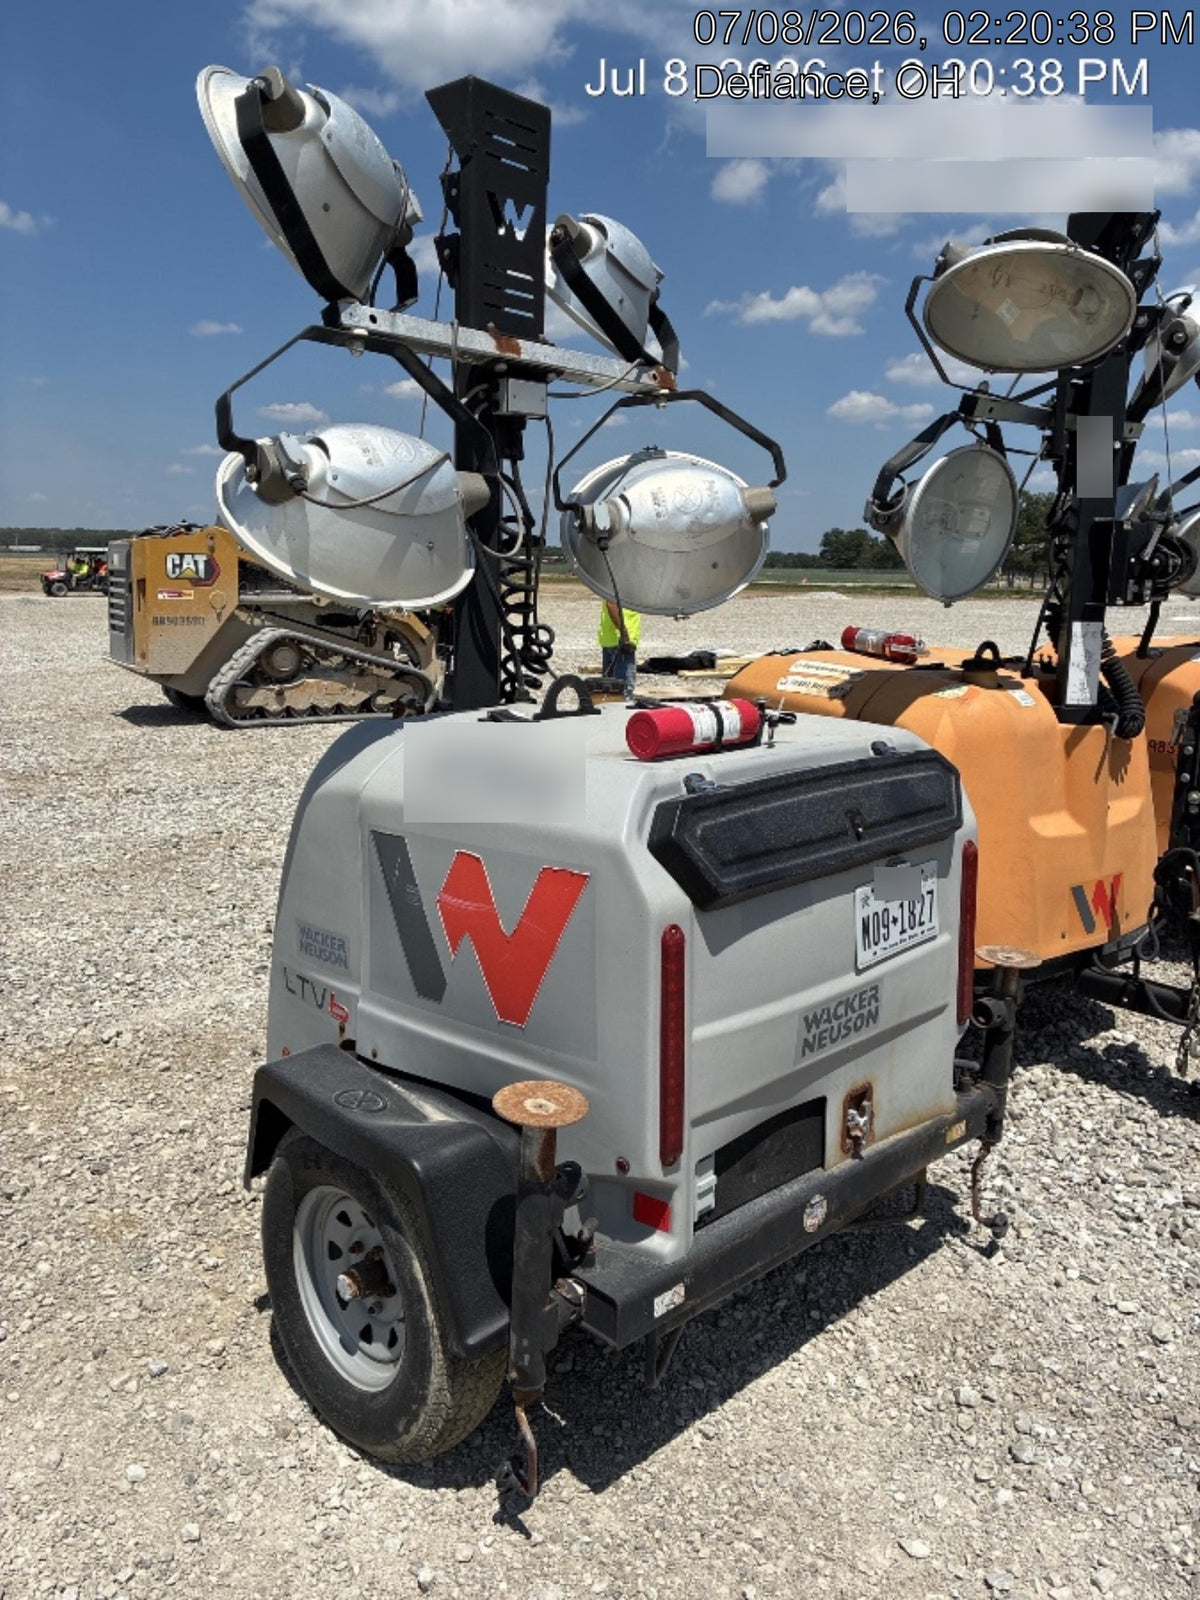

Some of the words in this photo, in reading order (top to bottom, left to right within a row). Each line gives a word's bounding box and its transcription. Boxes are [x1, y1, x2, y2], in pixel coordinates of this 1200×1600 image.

[166, 553, 209, 579] CAT
[299, 926, 346, 953] WACKER
[299, 940, 348, 969] NEUSON
[803, 984, 879, 1034] WACKER
[801, 1005, 879, 1058] NEUSON
